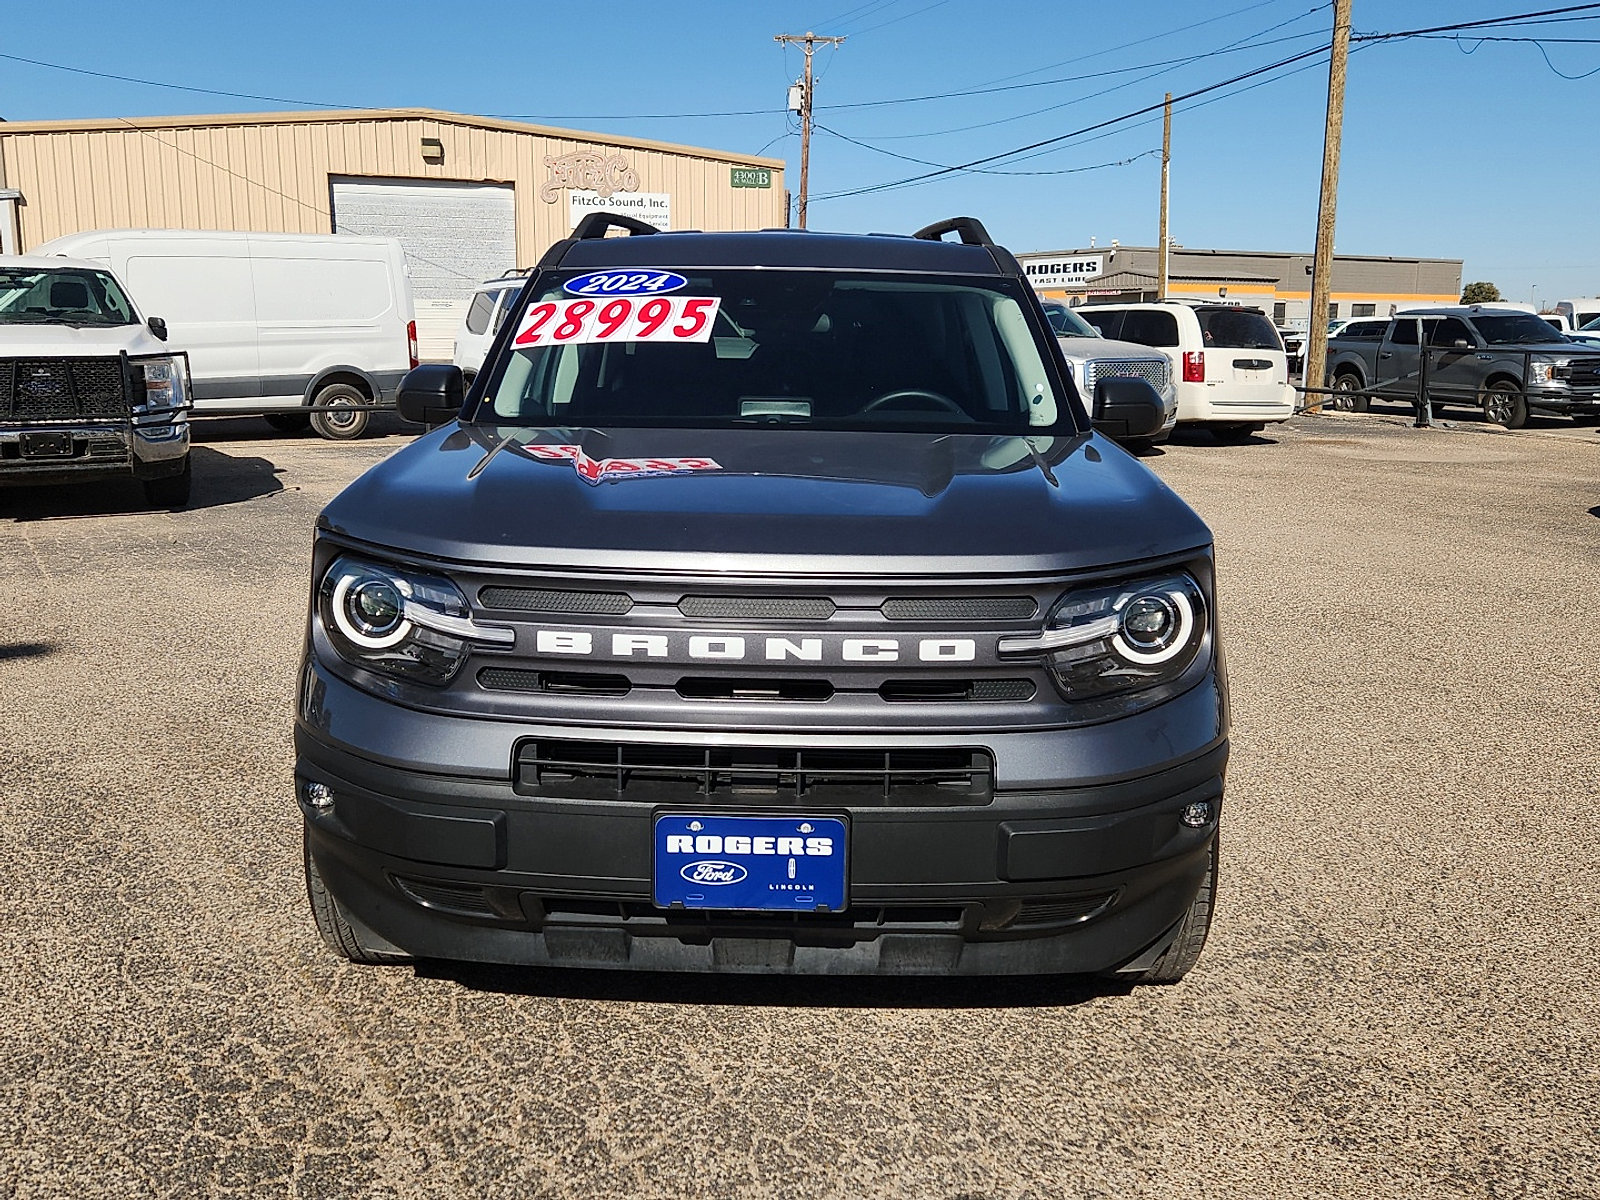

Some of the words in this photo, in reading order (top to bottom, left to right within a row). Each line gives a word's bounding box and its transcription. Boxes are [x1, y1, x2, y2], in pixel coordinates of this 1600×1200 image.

[733, 171, 756, 179] 4300
[758, 172, 769, 185] B
[572, 195, 606, 206] FitzCo
[608, 196, 647, 209] Sound,
[649, 198, 668, 208] Inc.
[1026, 261, 1097, 275] ROGERS
[578, 274, 671, 292] 2024
[515, 298, 717, 345] 28995
[536, 630, 976, 662] BRONCO
[666, 835, 833, 856] ROGERS
[692, 863, 735, 881] Ford
